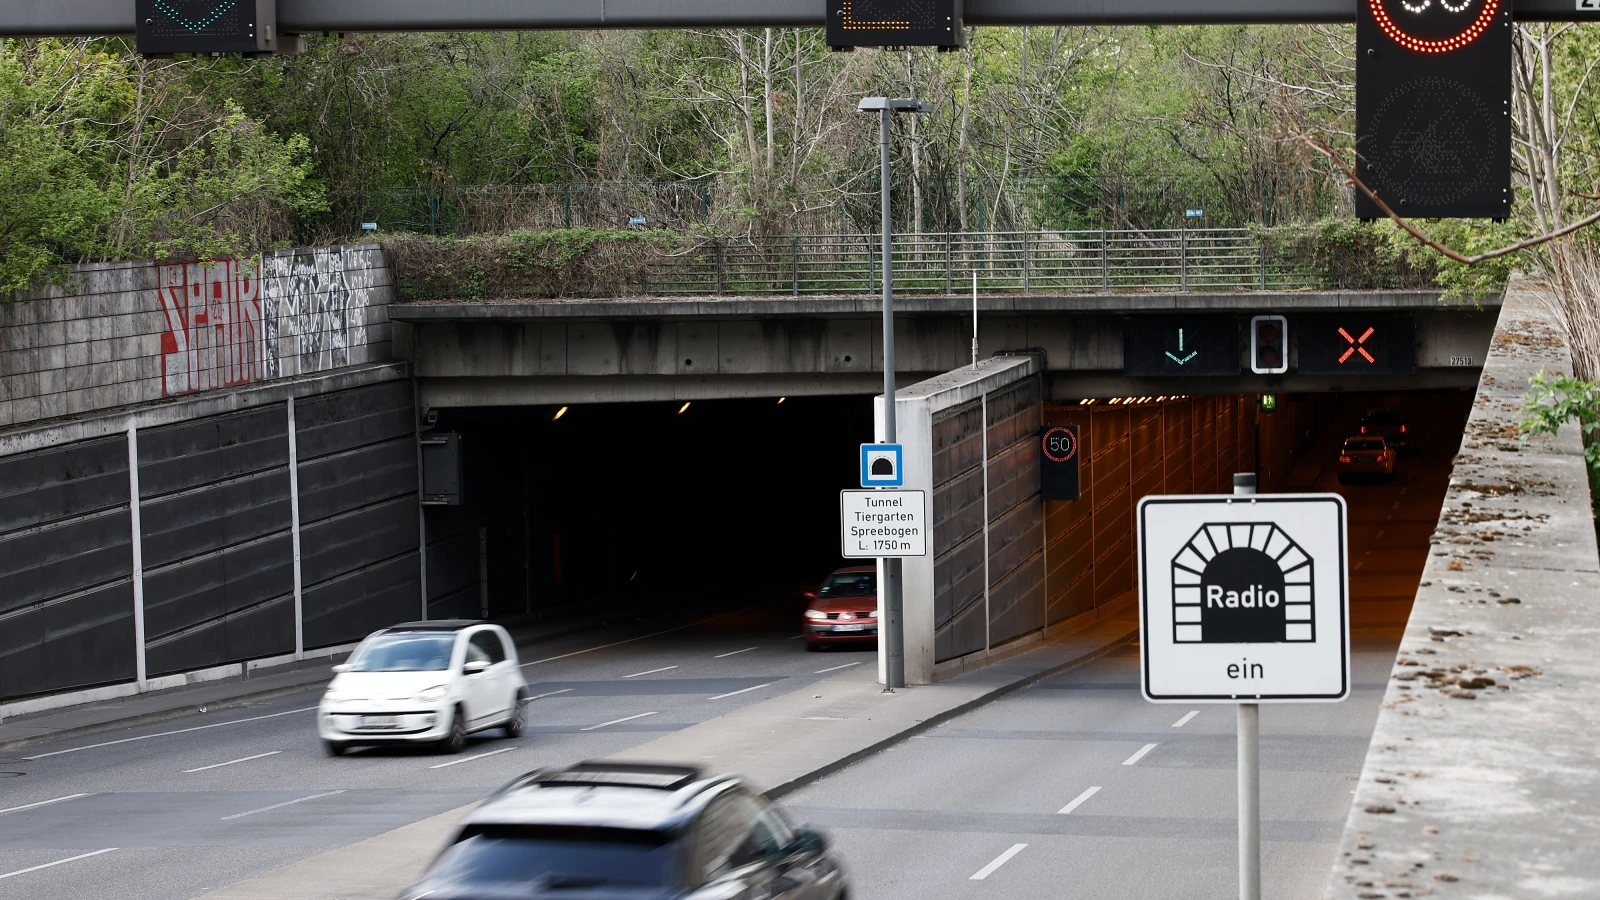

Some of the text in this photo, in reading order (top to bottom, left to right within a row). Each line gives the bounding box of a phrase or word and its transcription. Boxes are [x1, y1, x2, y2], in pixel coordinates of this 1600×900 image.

[1451, 357, 1472, 366] 27513
[1050, 437, 1070, 451] 50
[864, 497, 903, 507] Tunnel
[855, 511, 914, 524] Tiergarten
[851, 526, 919, 538] Spreebogen
[873, 540, 898, 550] 1750
[900, 542, 911, 550] m
[1206, 584, 1280, 608] Radio
[1227, 657, 1264, 679] ein
